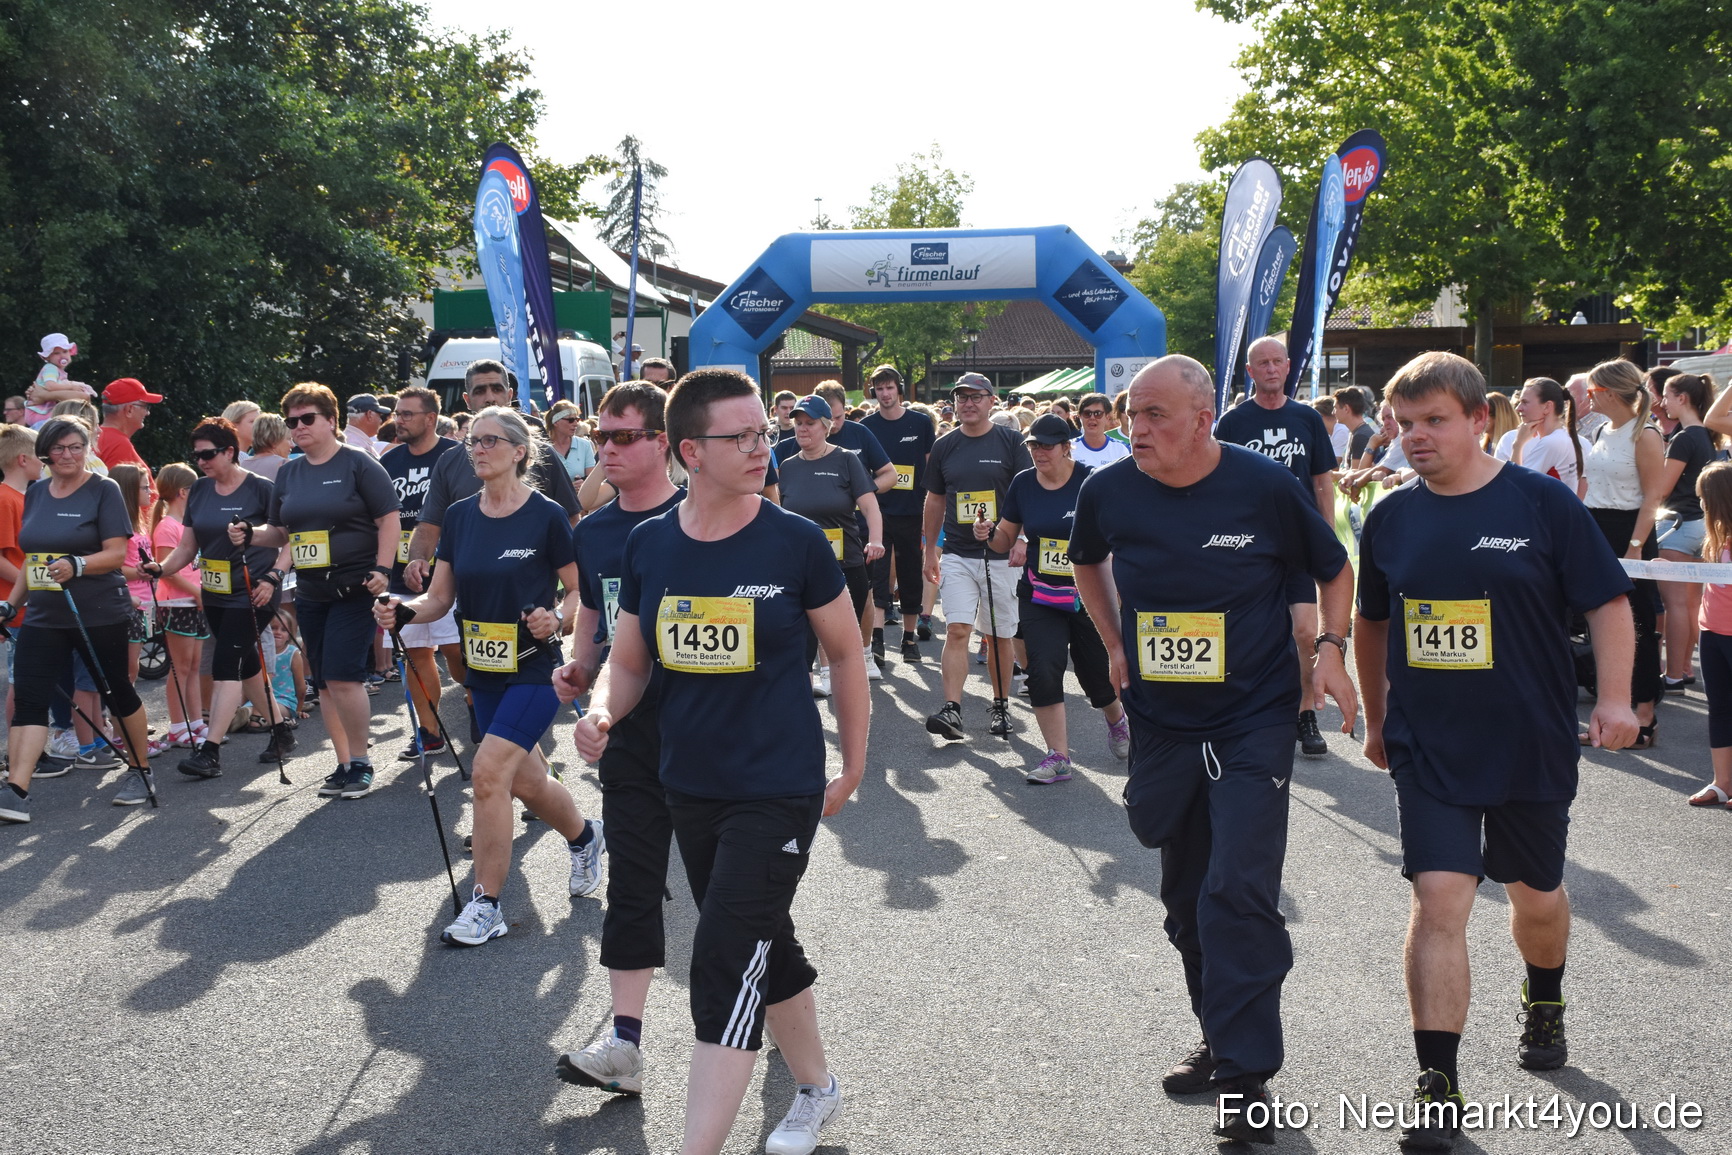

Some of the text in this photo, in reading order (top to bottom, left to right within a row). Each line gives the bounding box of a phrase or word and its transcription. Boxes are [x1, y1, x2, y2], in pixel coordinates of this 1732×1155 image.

[1343, 160, 1375, 191] ervis
[1236, 180, 1264, 261] Fischer
[1248, 190, 1270, 256] AUTOMOBILE
[919, 250, 946, 258] Fischer
[898, 265, 981, 281] firmenlauf
[739, 296, 784, 307] Fischer
[964, 502, 987, 515] 178
[1202, 534, 1242, 549] JURA
[1471, 536, 1513, 551] JURA
[295, 544, 317, 559] 170
[498, 549, 526, 559] JURA
[1044, 551, 1070, 566] 145
[203, 571, 222, 584] 175
[727, 585, 769, 598] JURA
[667, 623, 739, 652] 1430
[1413, 624, 1479, 650] 1418
[468, 638, 508, 659] 1462
[676, 651, 732, 661] Peters Beatrice
[1146, 637, 1212, 662] 1392
[1440, 650, 1467, 658] Markus
[1160, 662, 1179, 670] Ferstl
